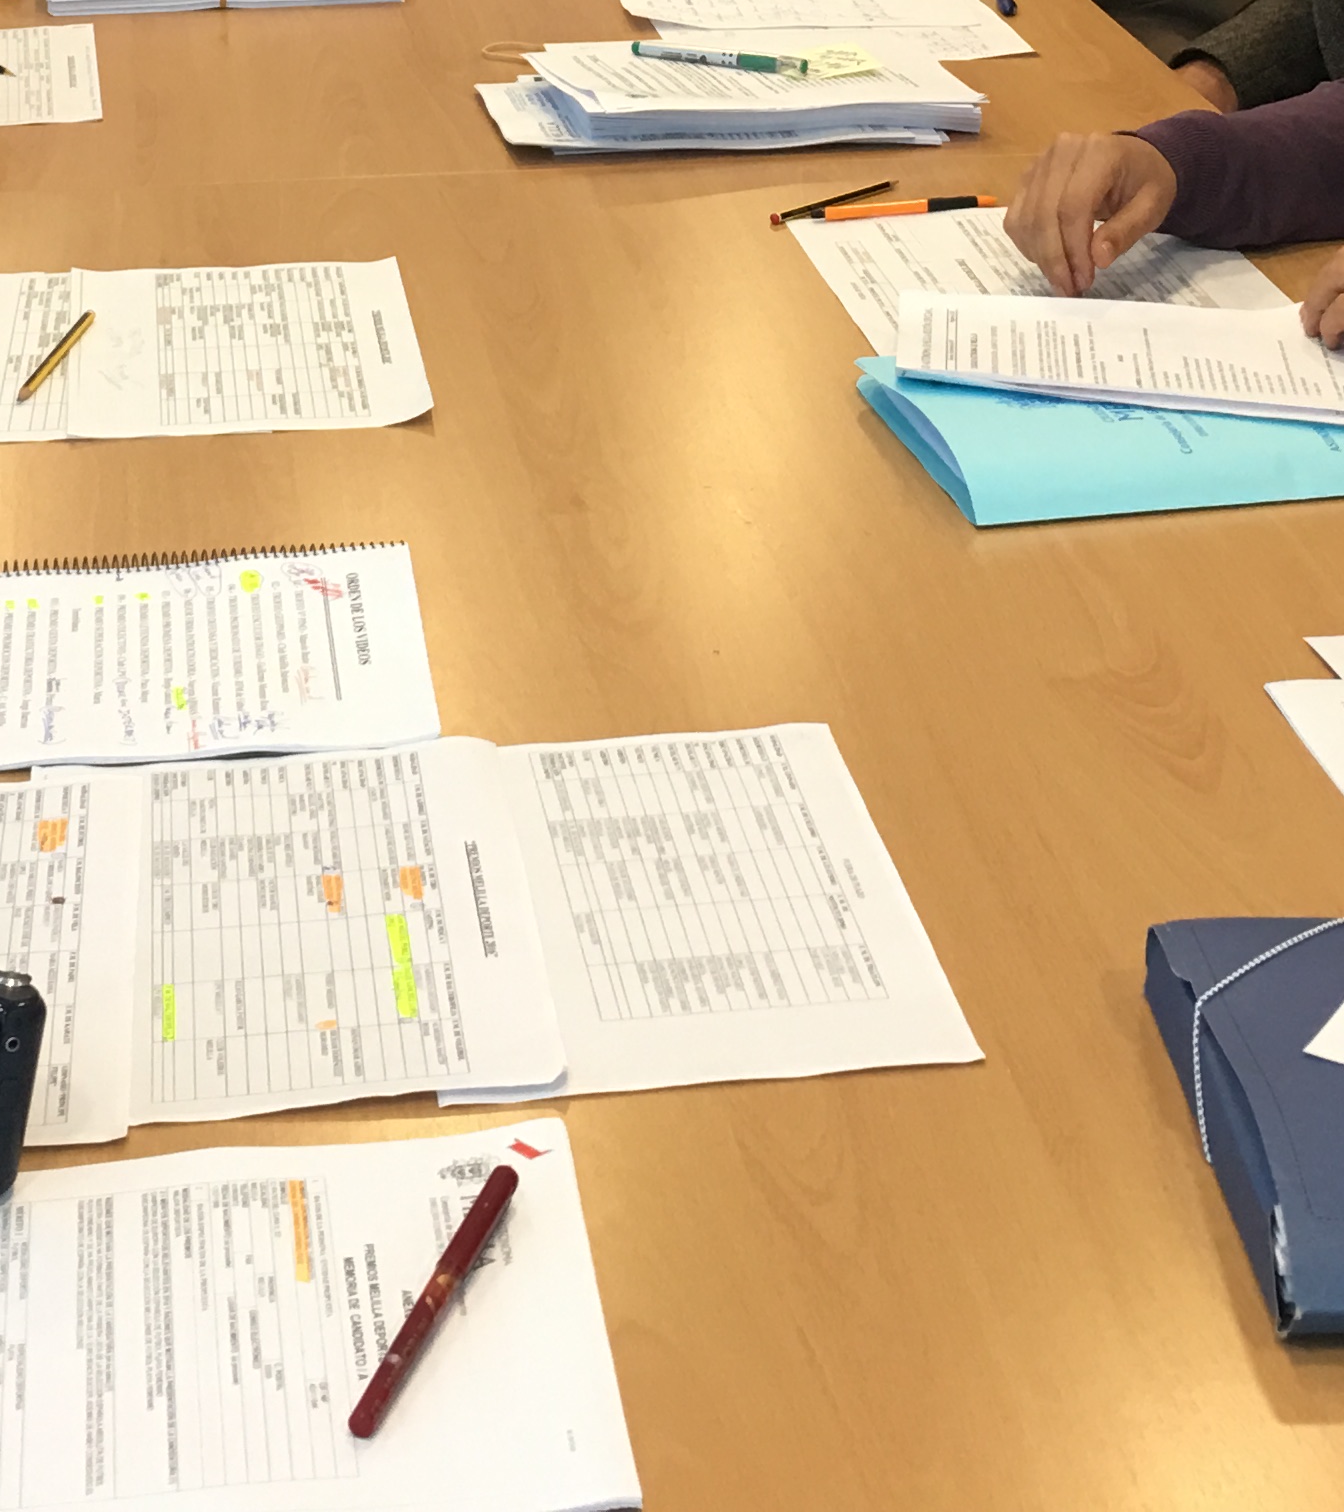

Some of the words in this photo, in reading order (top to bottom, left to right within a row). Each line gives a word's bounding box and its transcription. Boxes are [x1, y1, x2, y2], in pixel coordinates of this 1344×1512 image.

[346, 573, 362, 601] ORDEN
[350, 603, 364, 614] DE
[351, 615, 367, 633] LOS
[354, 634, 371, 665] VIDEOS
[343, 1257, 358, 1297] MEMORIA
[364, 1244, 378, 1282] PREMIOS
[347, 1298, 360, 1310] DE
[369, 1283, 384, 1319] MELILLA
[349, 1314, 367, 1367] CANDIDATO
